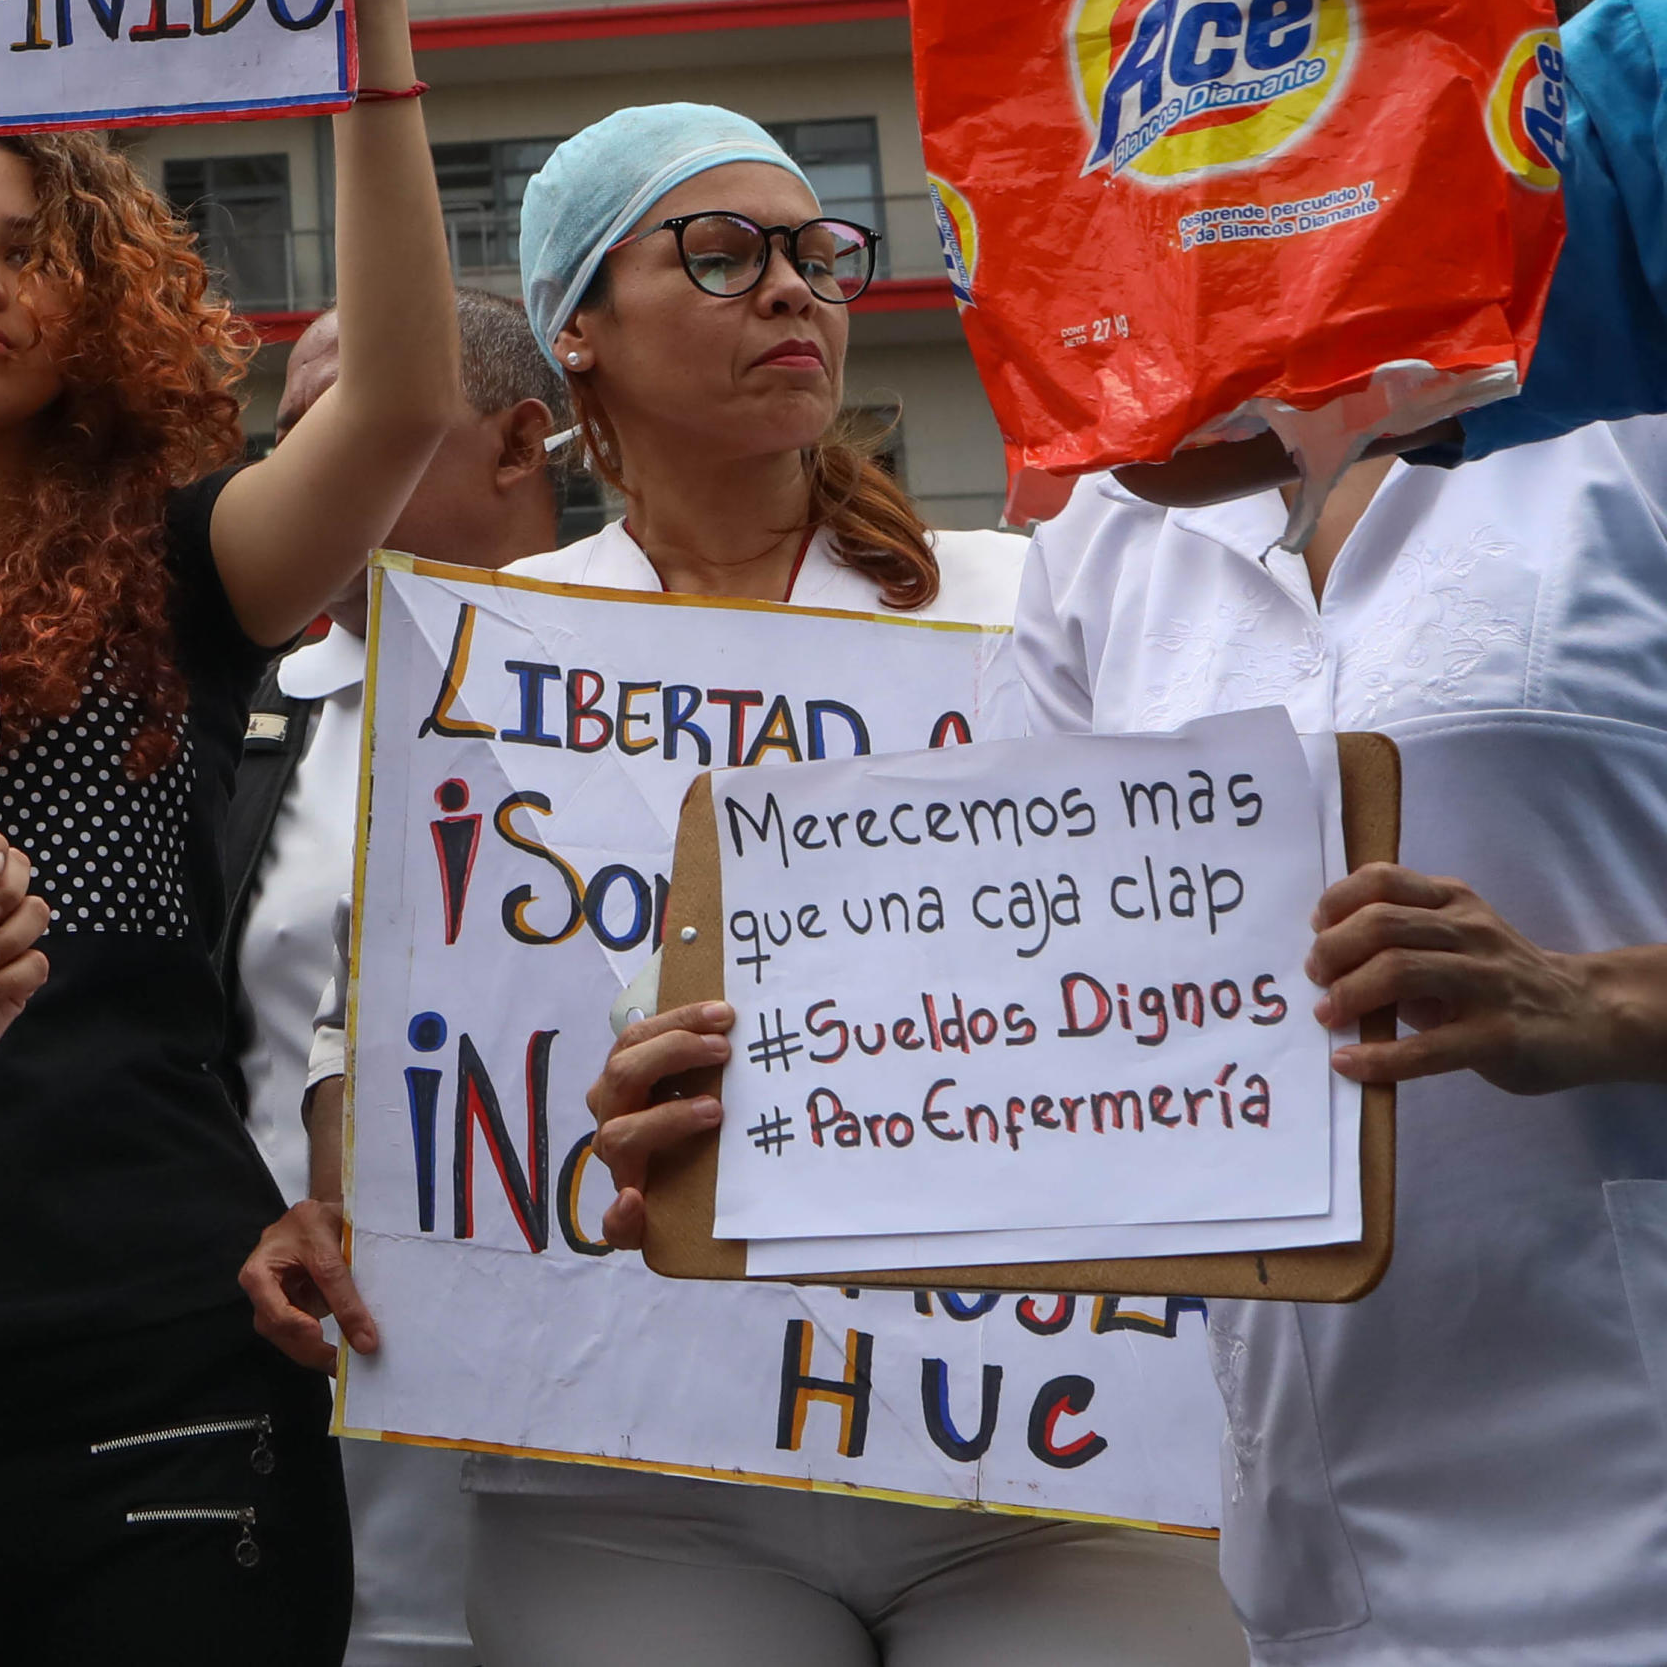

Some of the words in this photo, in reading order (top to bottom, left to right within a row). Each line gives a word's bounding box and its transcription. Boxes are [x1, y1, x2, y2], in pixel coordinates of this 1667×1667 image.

[1113, 98, 1182, 173] Blancos
[1184, 58, 1325, 117] Diamante
[1196, 227, 1215, 243] da
[1220, 221, 1293, 241] Blancos
[1299, 198, 1379, 232] Diamante
[1271, 186, 1357, 221] percudido
[419, 603, 870, 765] LIBERTAD
[724, 788, 1096, 867] Merecemos
[1121, 770, 1263, 831] mas
[729, 901, 828, 984] que
[843, 885, 946, 935] una
[972, 873, 1080, 959] caja
[1110, 855, 1245, 935] clap
[748, 991, 1037, 1073] #Sueldos
[1058, 972, 1289, 1046] Dignos
